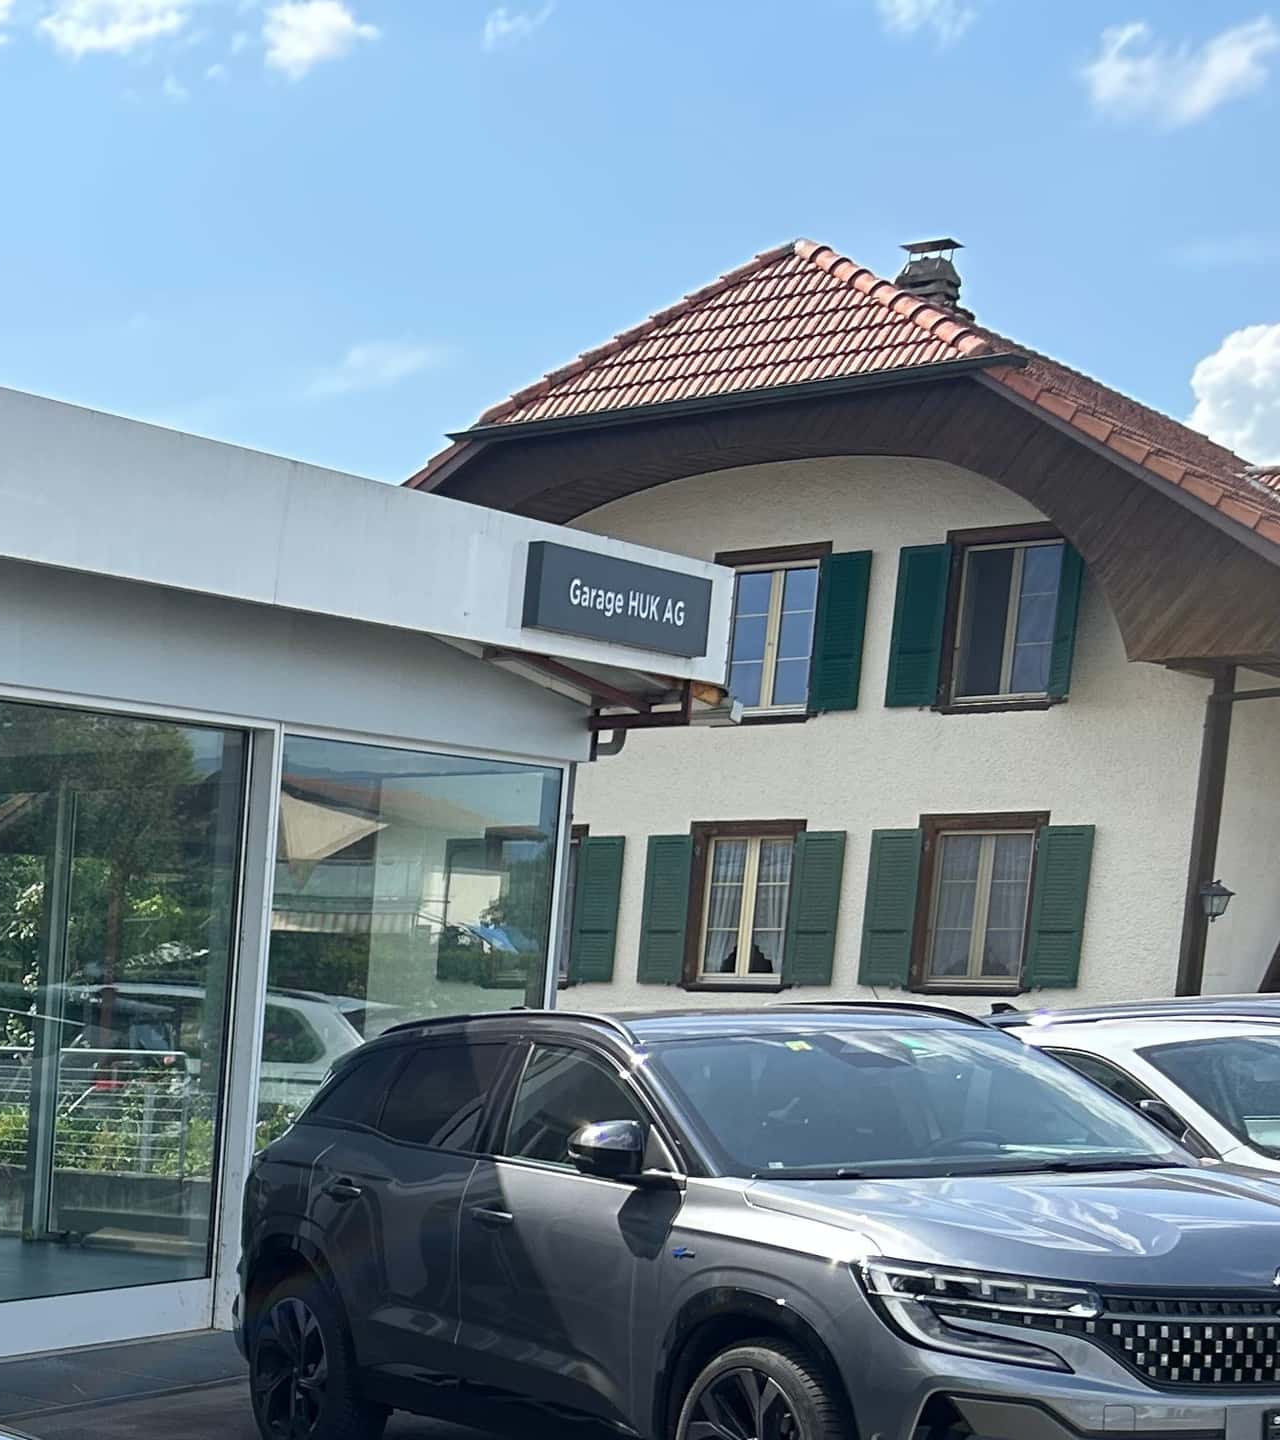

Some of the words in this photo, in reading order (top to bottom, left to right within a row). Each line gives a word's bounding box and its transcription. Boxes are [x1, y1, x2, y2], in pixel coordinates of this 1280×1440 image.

[570, 579, 624, 616] Garage
[628, 590, 660, 621] HUK
[662, 598, 686, 627] AG
